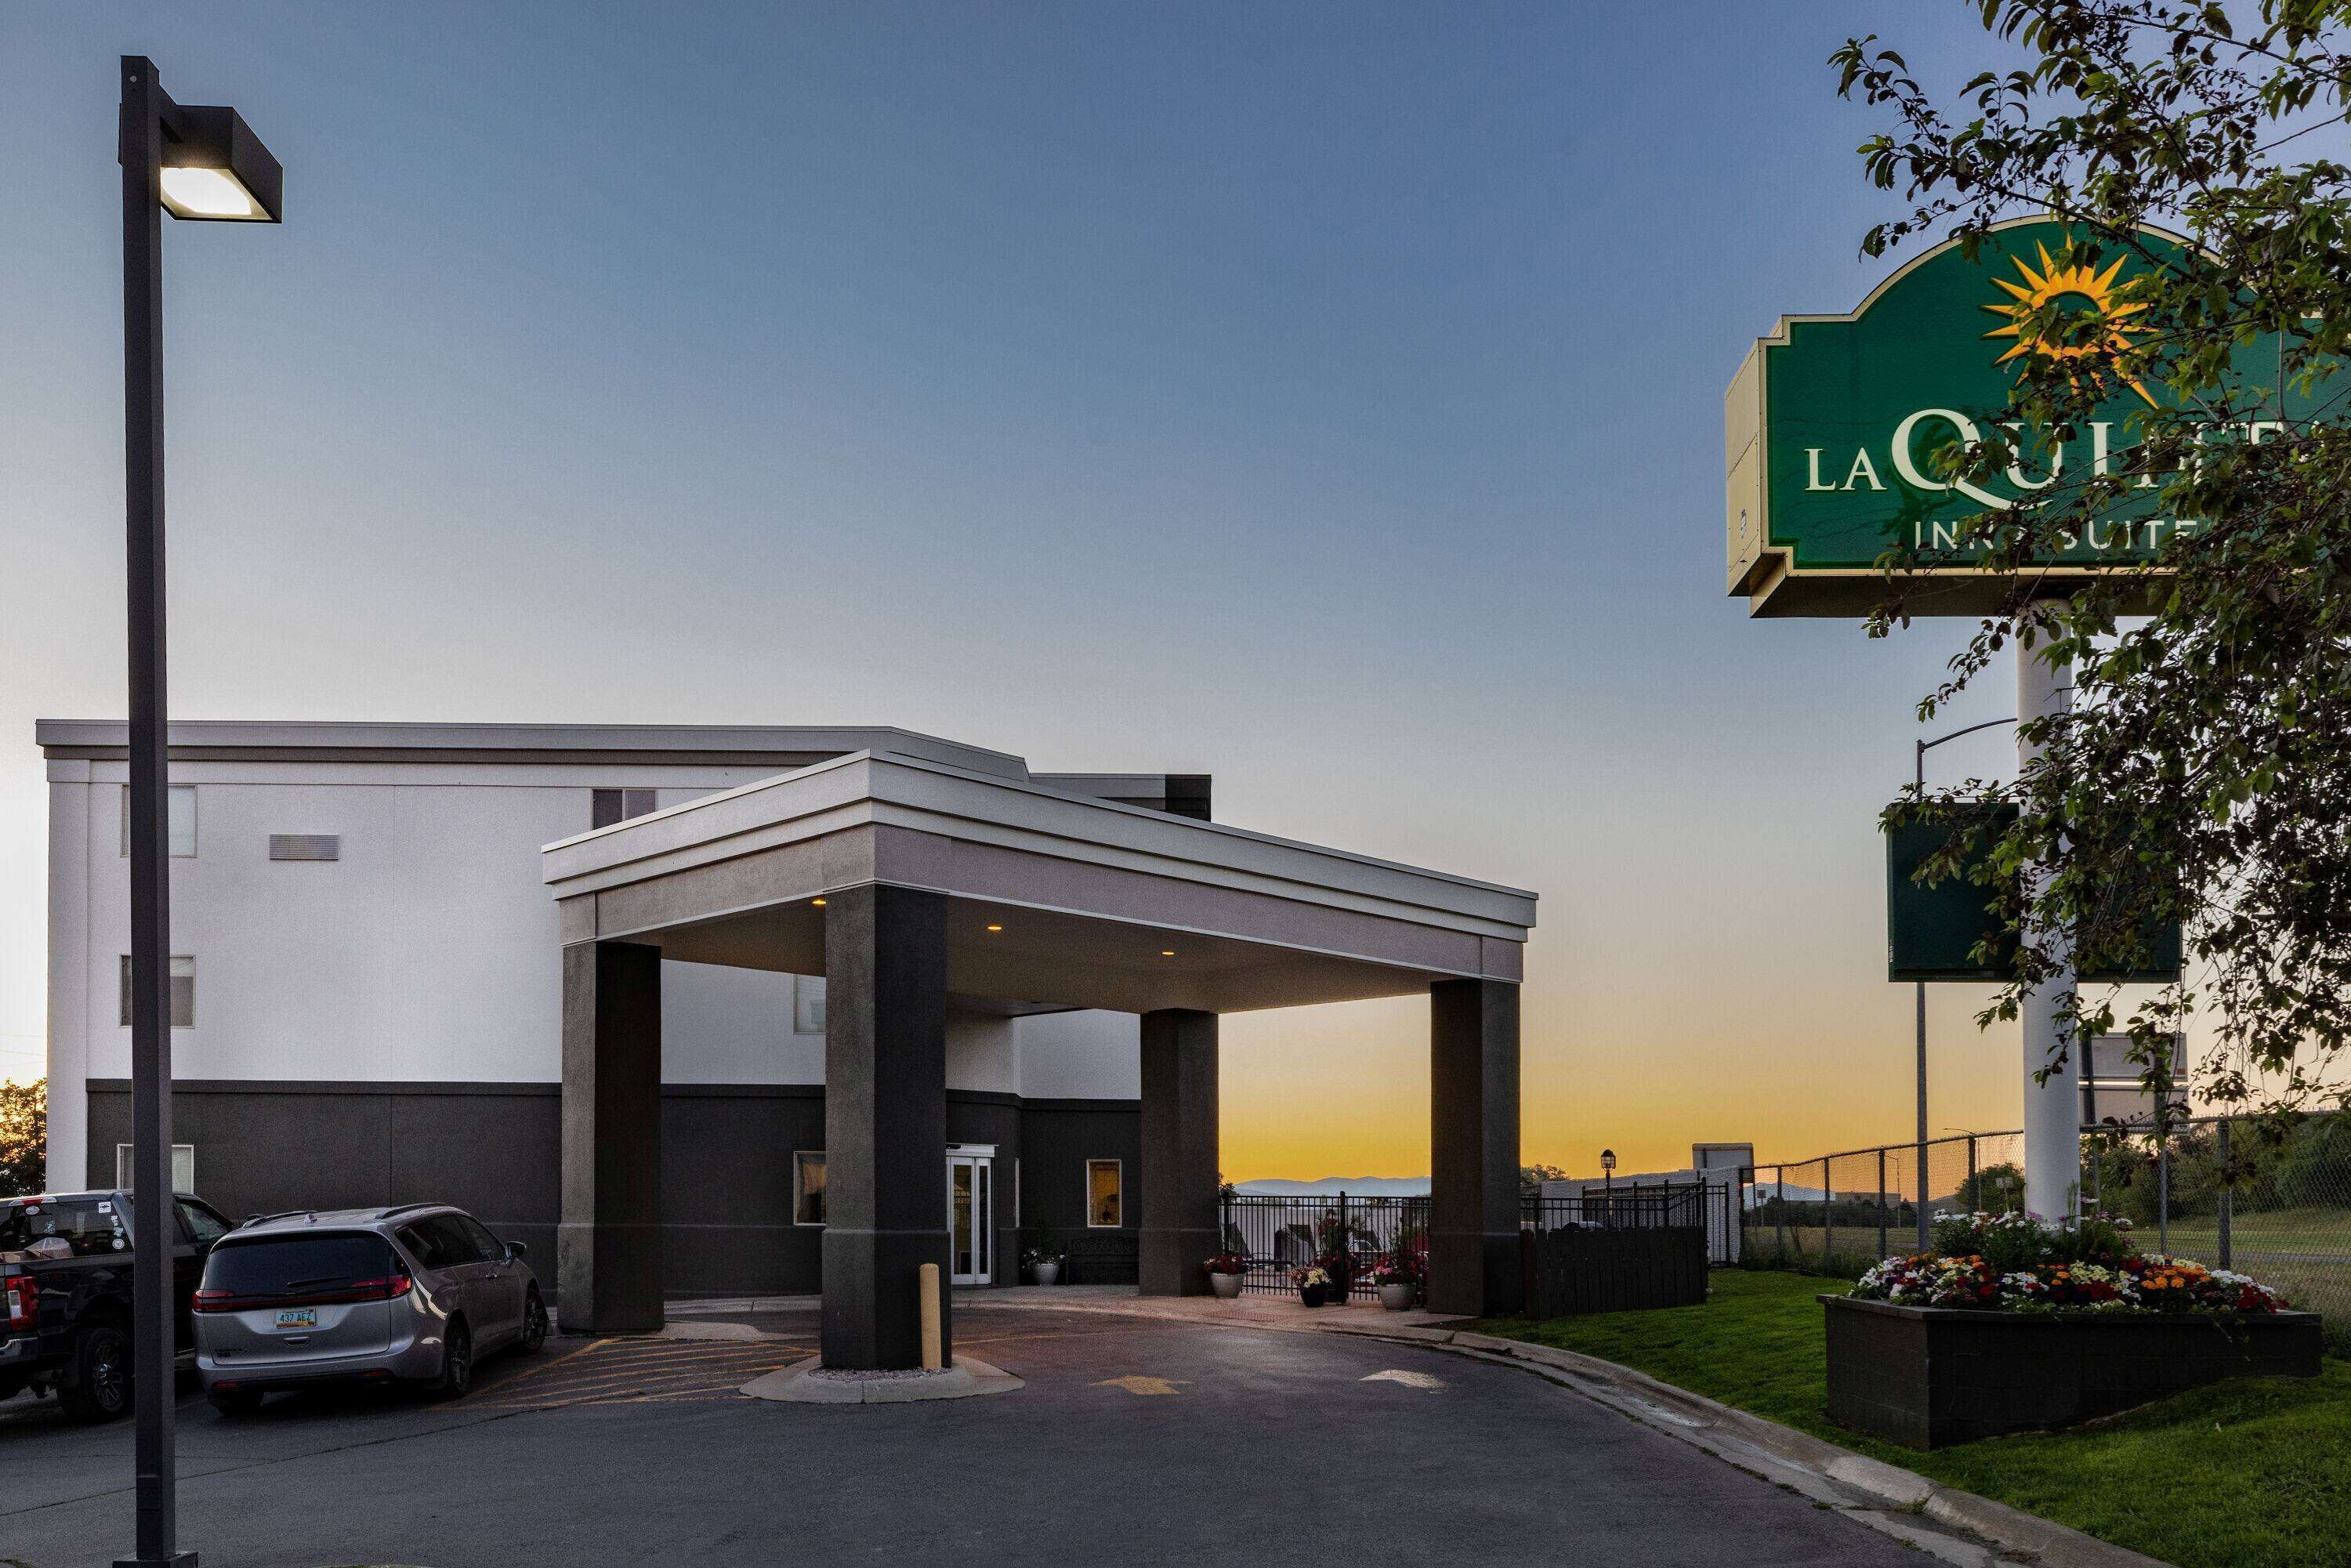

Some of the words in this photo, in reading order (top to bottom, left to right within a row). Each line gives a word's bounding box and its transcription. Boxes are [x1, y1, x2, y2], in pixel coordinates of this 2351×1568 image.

[1805, 447, 1887, 491] LA
[1891, 408, 2339, 511] QUIT
[2056, 520, 2230, 550] SUITE
